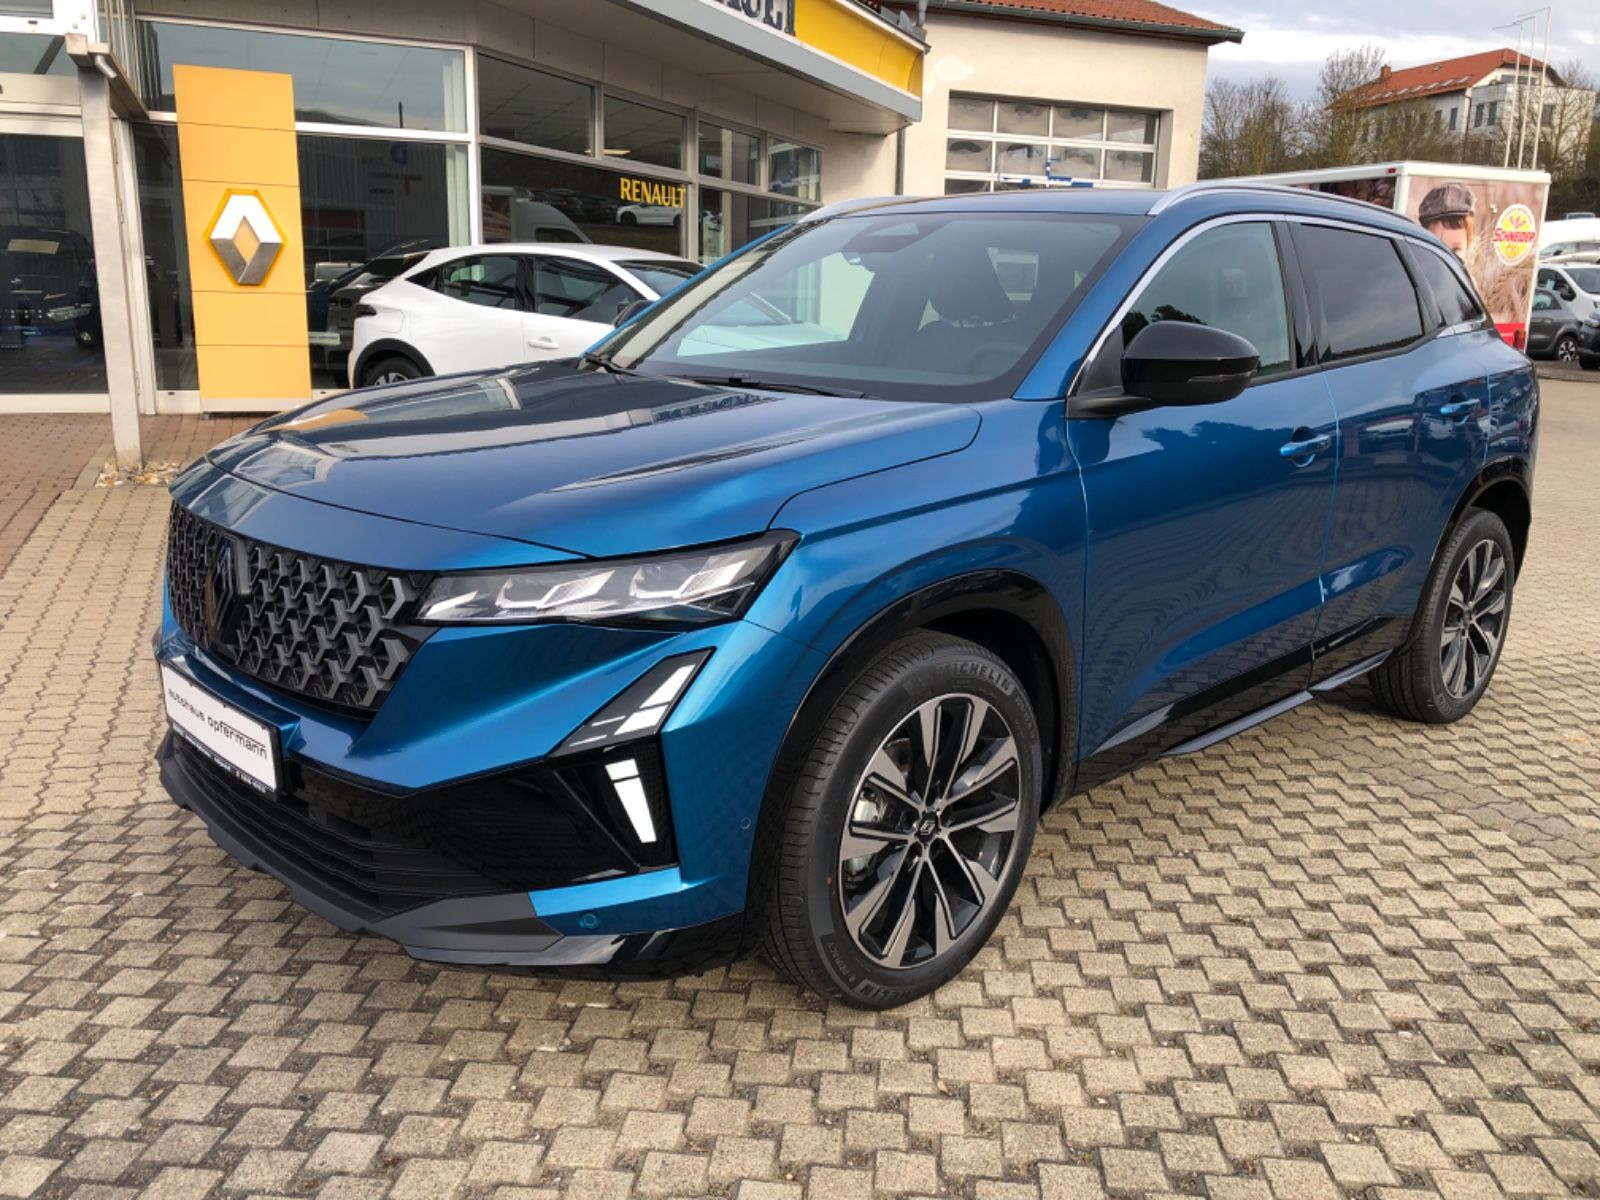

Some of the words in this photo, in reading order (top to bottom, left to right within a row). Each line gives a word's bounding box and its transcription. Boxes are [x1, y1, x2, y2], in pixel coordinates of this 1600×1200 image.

[620, 177, 686, 208] RENAULT
[168, 688, 205, 722] autohaus
[207, 716, 267, 760] opfermann
